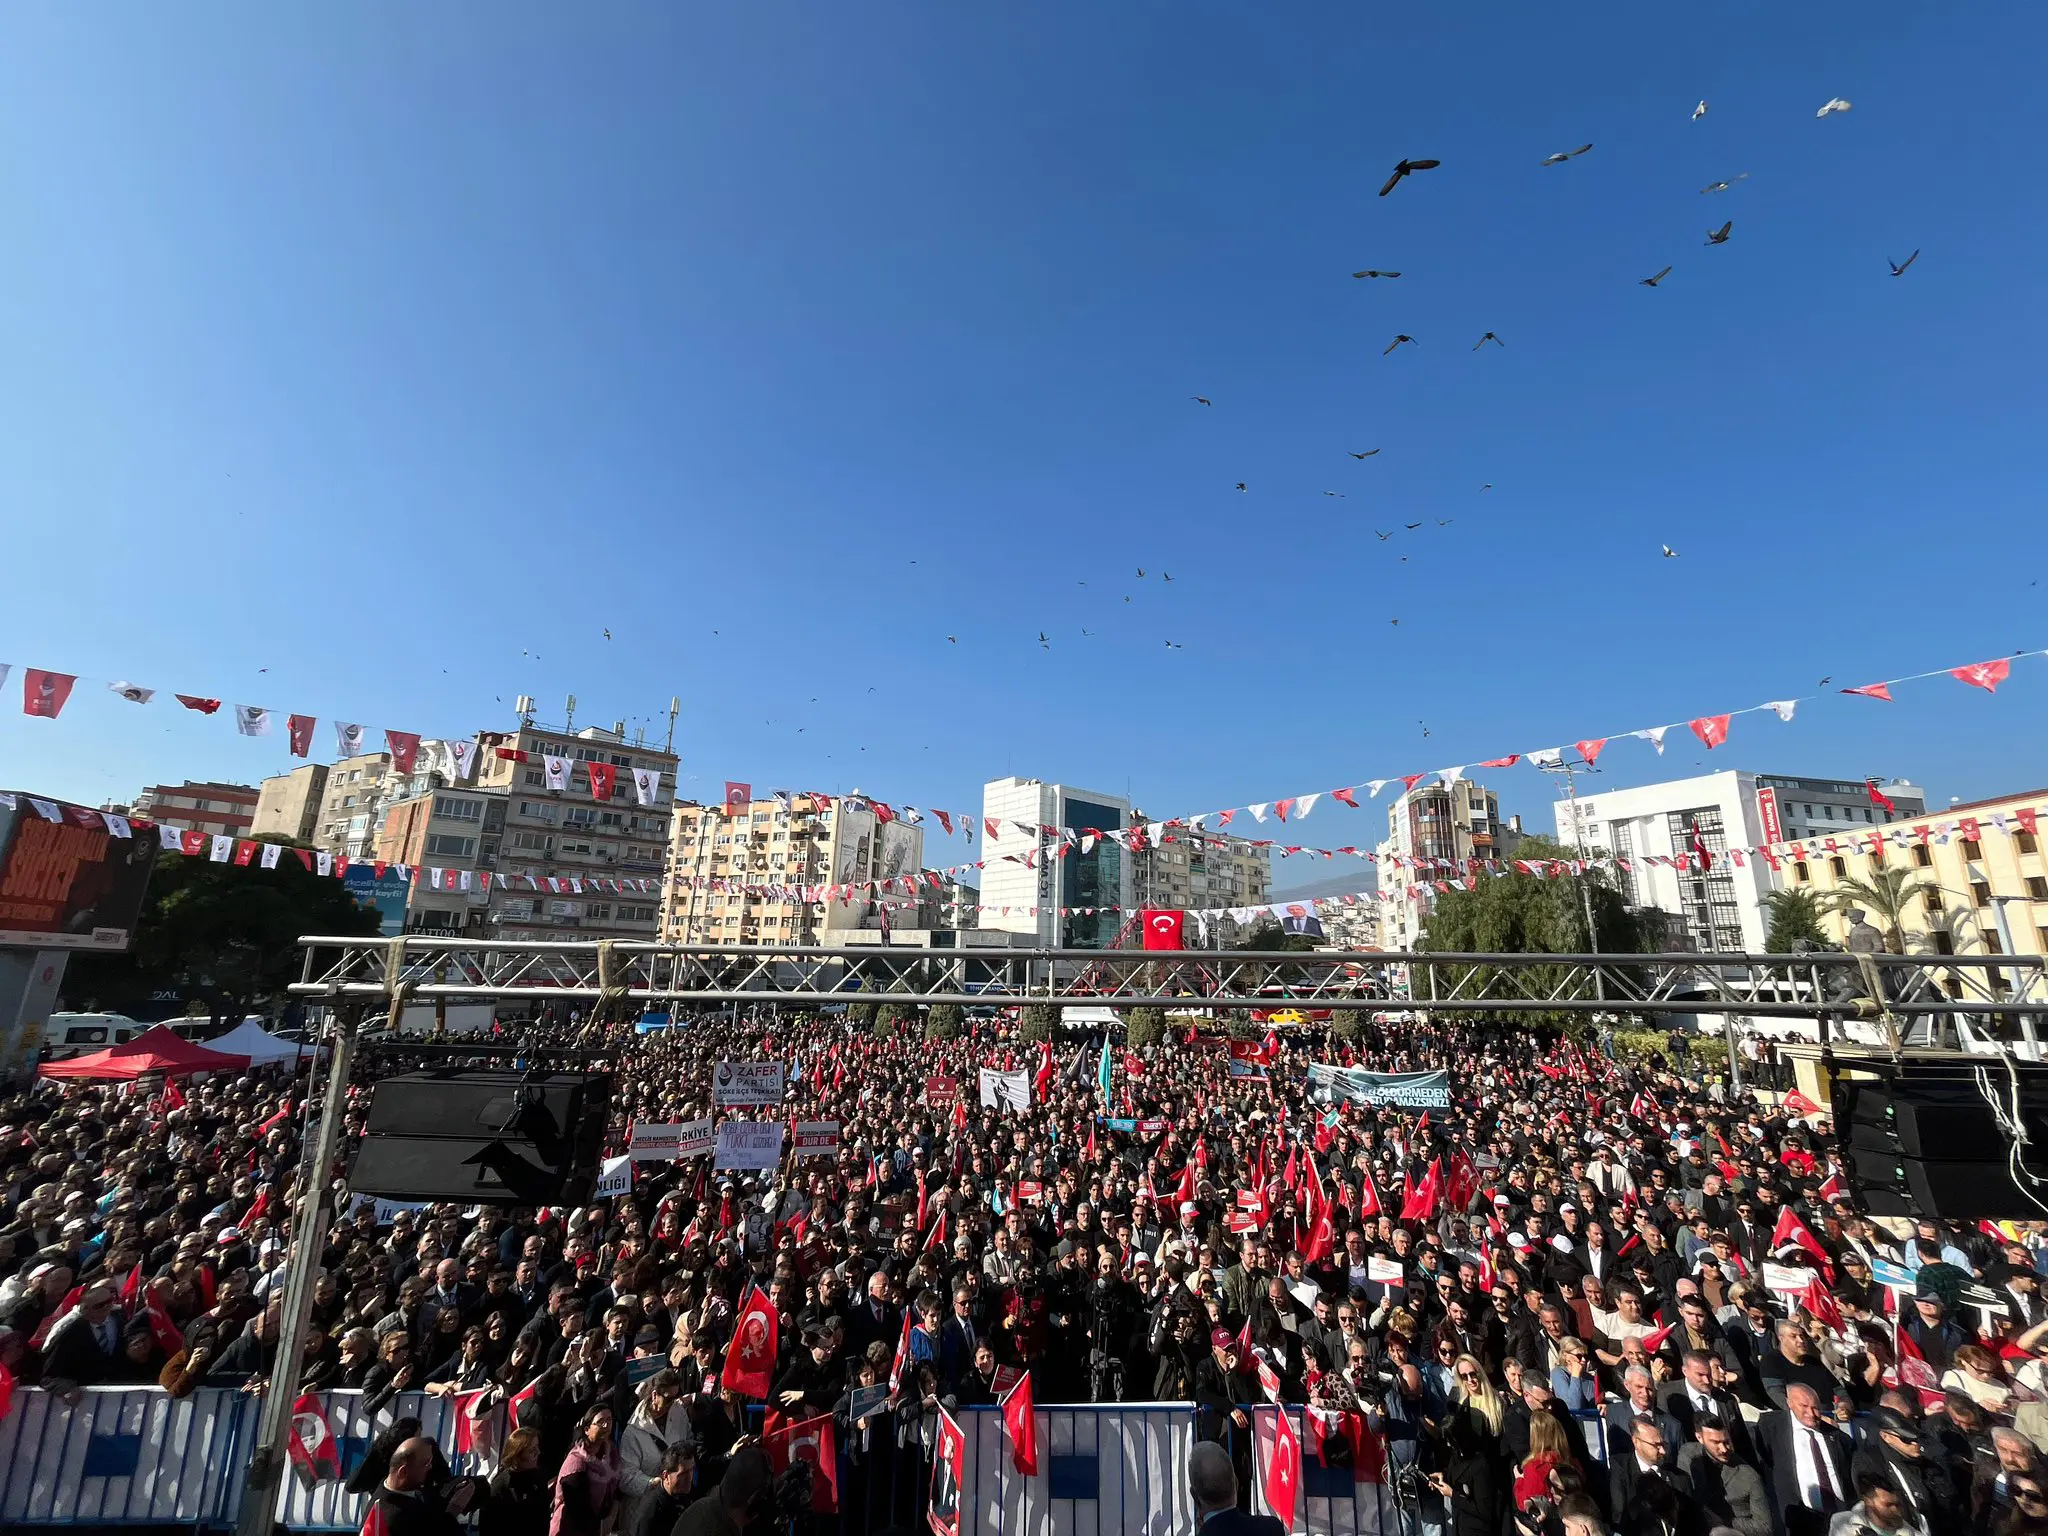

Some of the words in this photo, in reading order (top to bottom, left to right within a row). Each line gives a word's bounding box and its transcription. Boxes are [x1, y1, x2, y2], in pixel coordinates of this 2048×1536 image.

[1764, 802, 1776, 832] Bornova
[413, 927, 456, 938] TATTOO
[736, 1065, 778, 1077] ZAFER
[718, 1087, 735, 1095] SÖKE
[1376, 1086, 1448, 1098] ÖLDÜRMEDEN
[802, 1136, 819, 1146] DUR
[819, 1136, 830, 1145] DE
